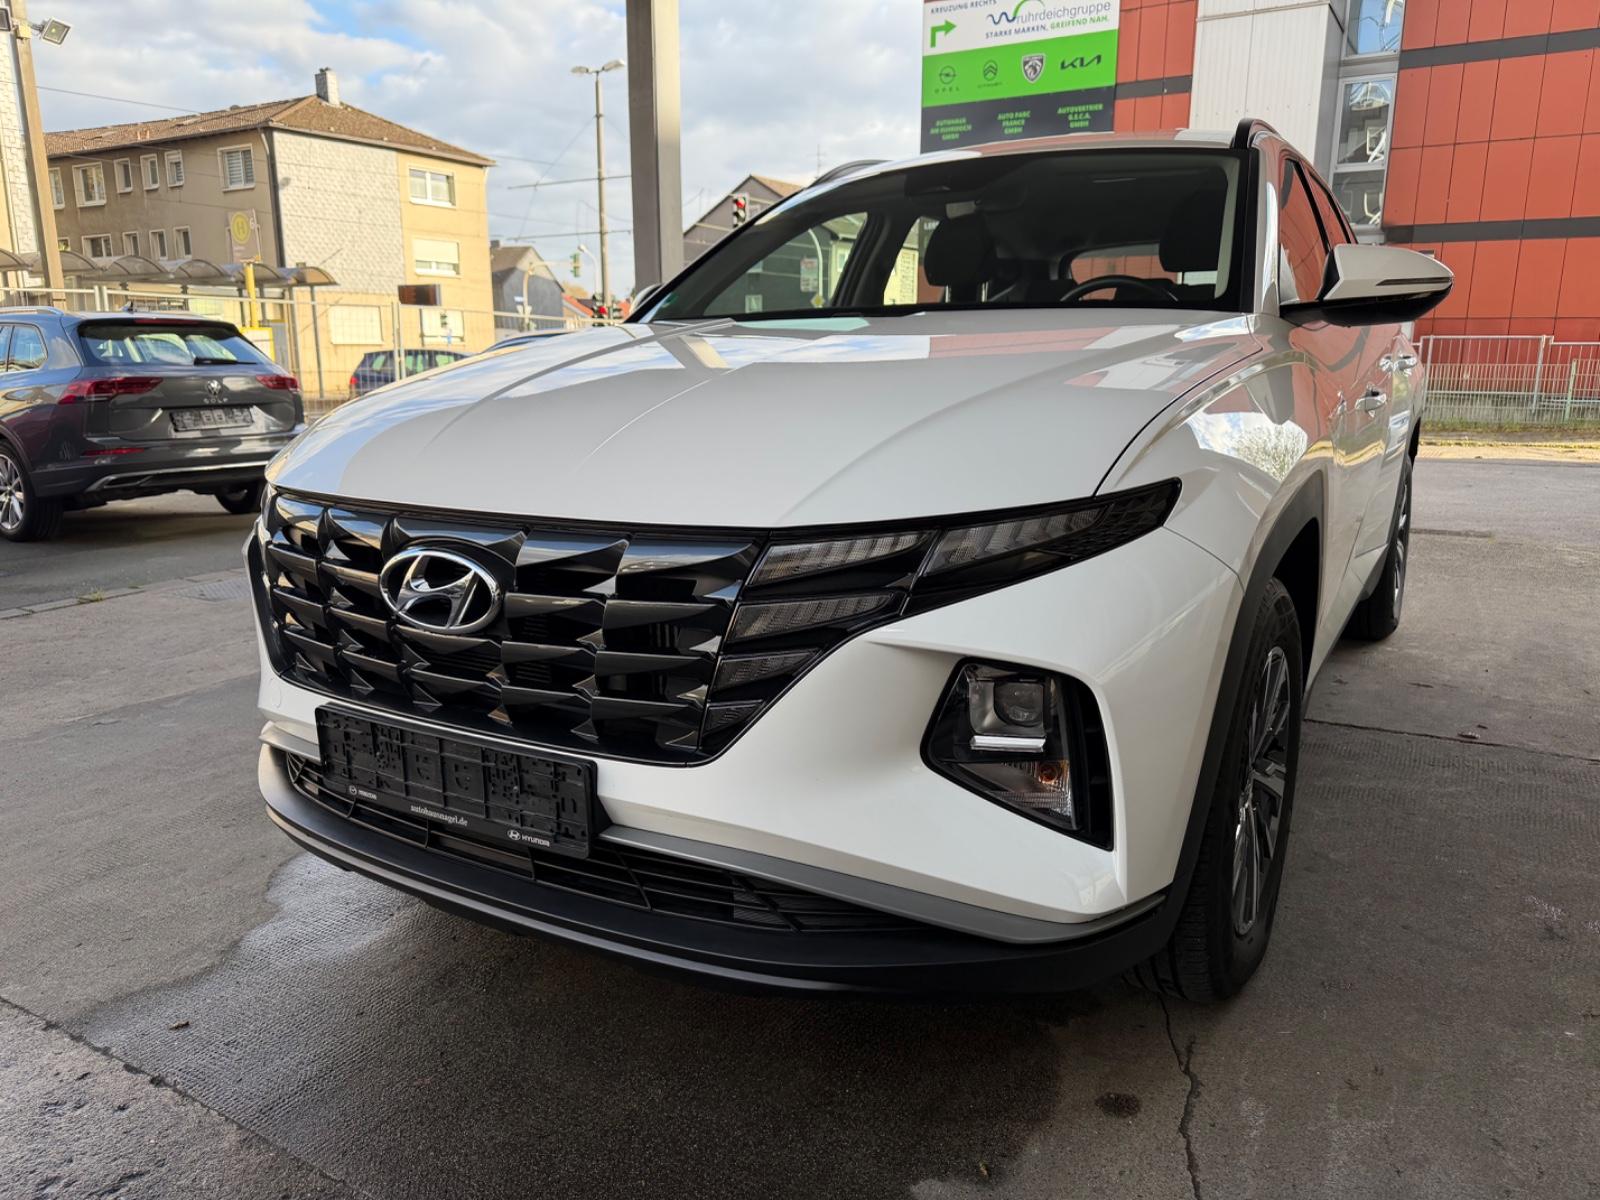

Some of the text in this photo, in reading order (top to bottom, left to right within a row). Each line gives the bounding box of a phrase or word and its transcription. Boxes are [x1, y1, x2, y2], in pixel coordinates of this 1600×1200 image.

[931, 0, 997, 14] KREUZUNG RECHTS
[985, 28, 1013, 39] STARKE
[1050, 18, 1088, 30] GREIFEND
[521, 834, 550, 847] HYUNDAI
